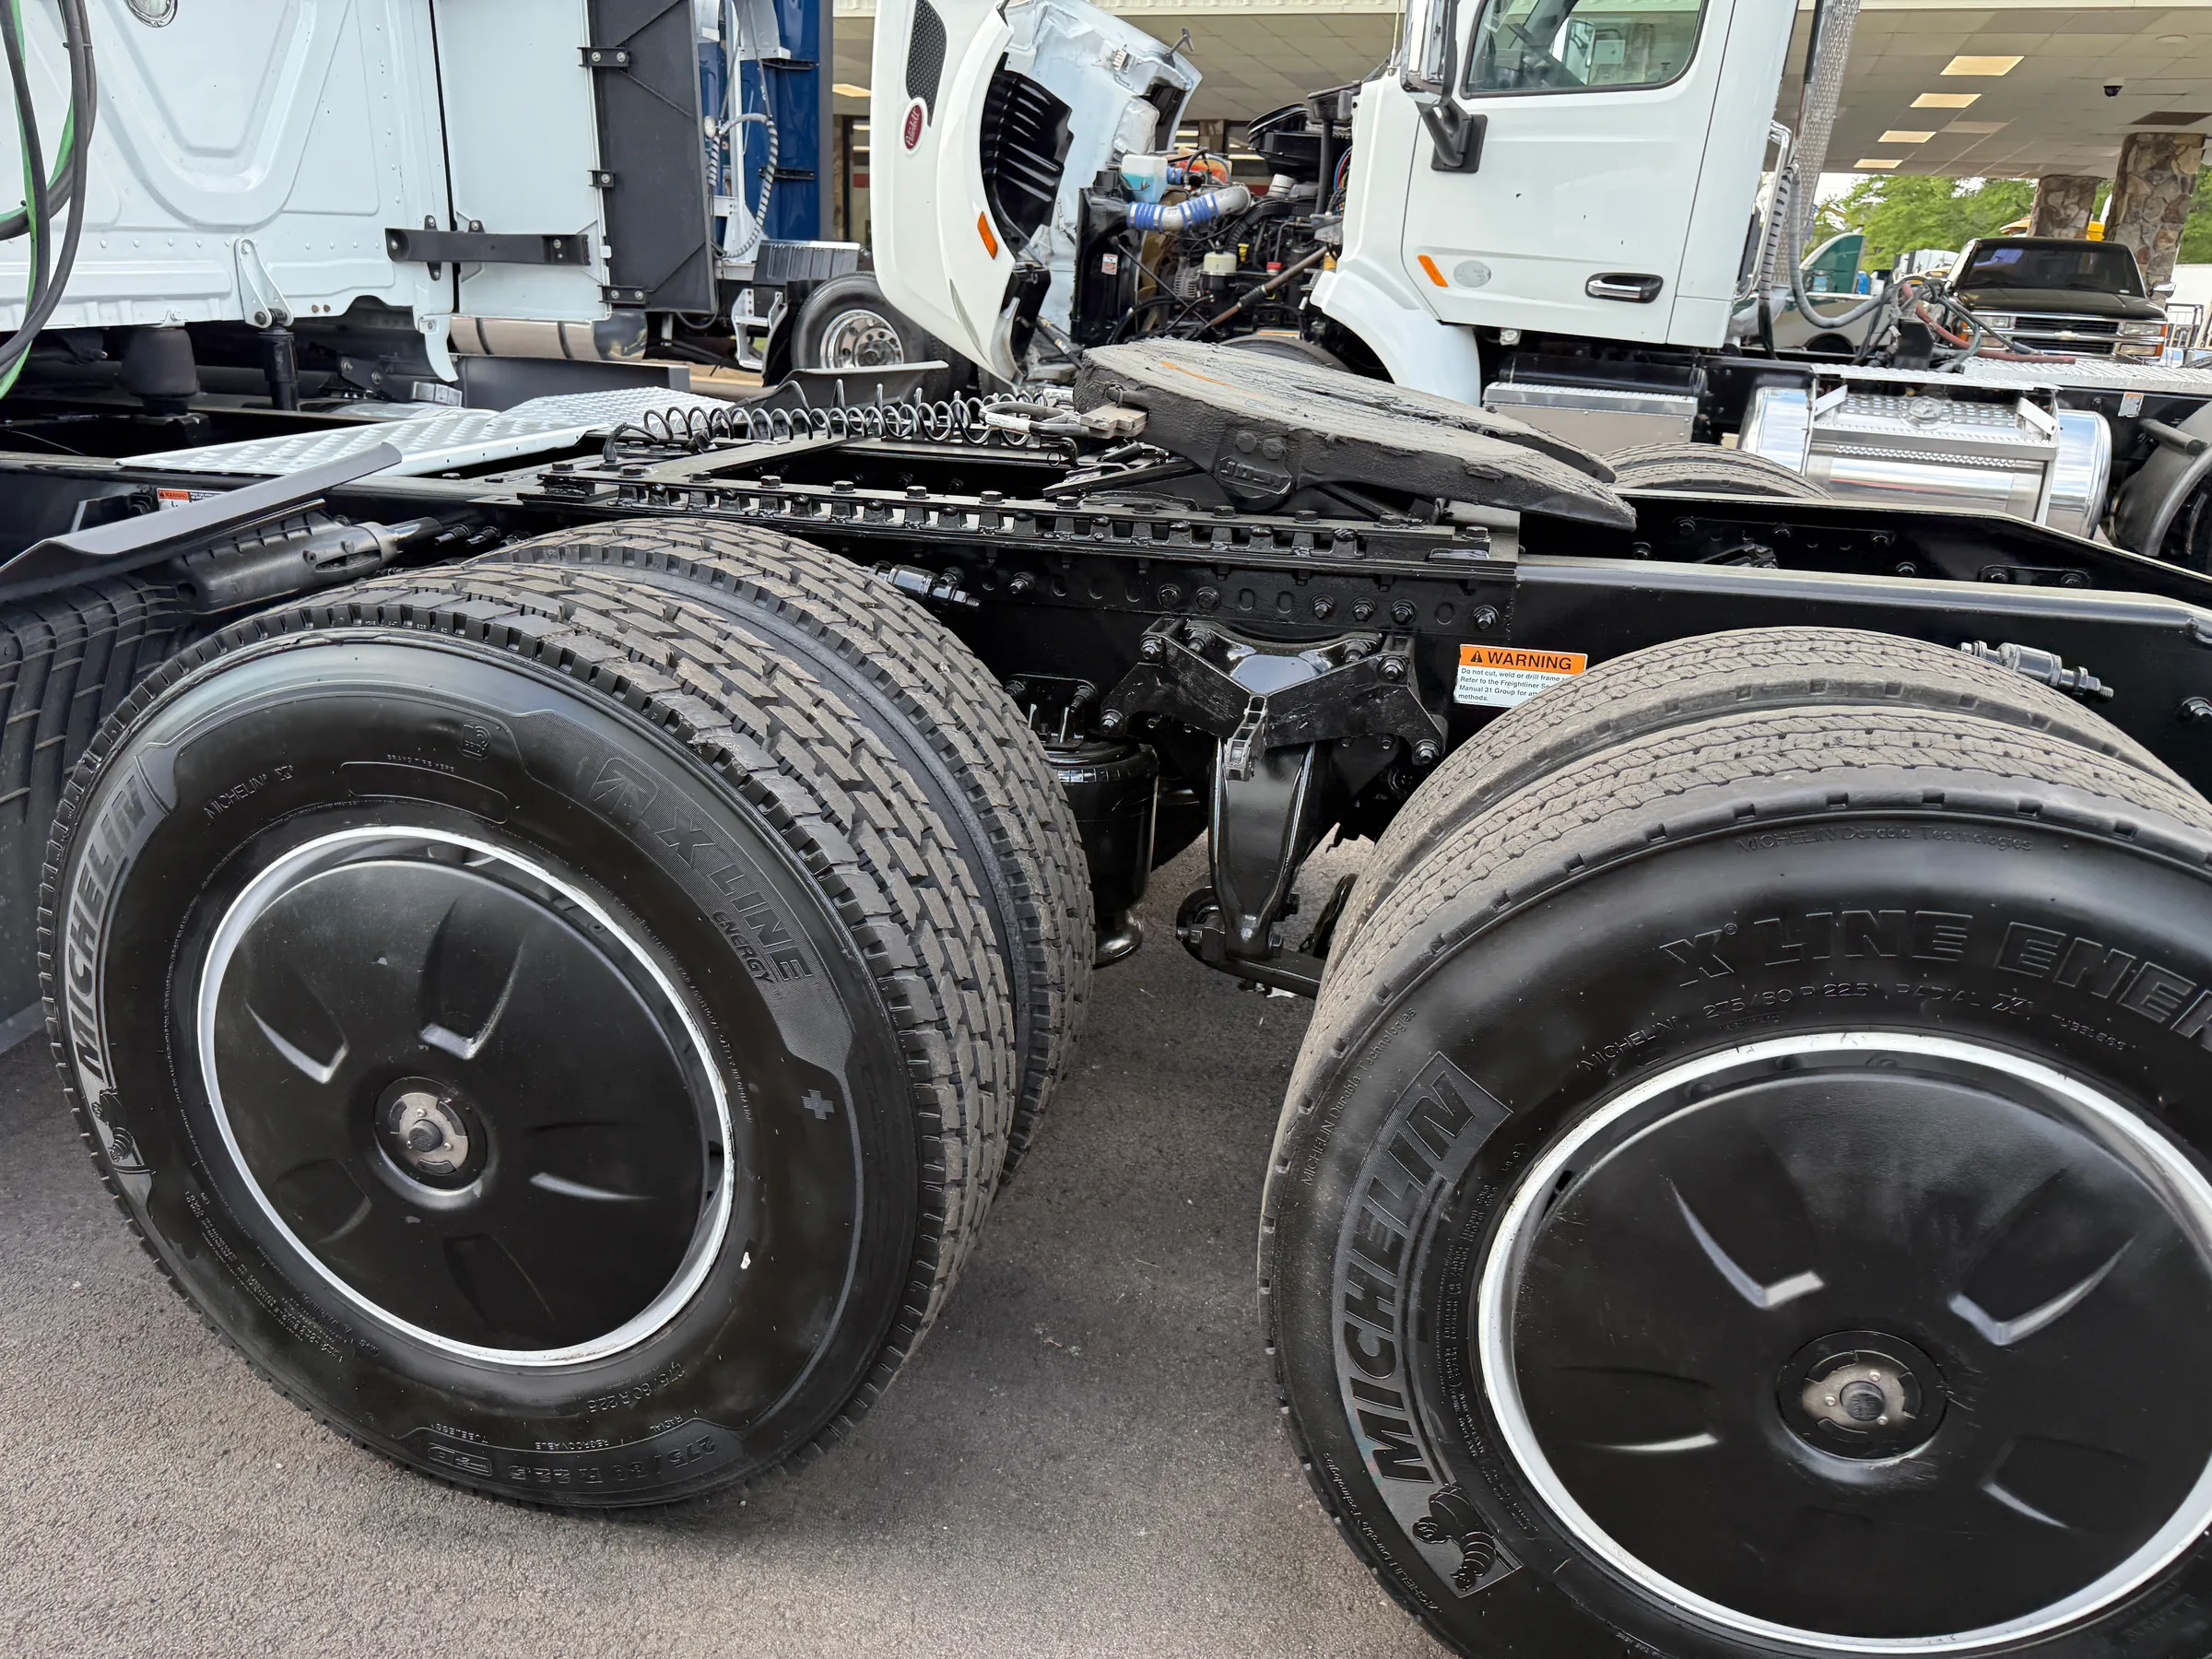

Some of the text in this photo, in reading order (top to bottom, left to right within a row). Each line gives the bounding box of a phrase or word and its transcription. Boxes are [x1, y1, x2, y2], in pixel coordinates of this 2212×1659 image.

[1488, 651, 1571, 670] WARNING
[1500, 680, 1538, 688] Freightliner
[204, 774, 265, 819] MICHELIN
[1920, 826, 2033, 852] Technologies
[654, 809, 813, 981] X LINE
[66, 774, 147, 1082] MICHELIN
[712, 909, 774, 983] ENERGY
[1754, 910, 1972, 966] LINE
[1581, 1017, 1676, 1071] MICHELIN
[1824, 982, 1870, 998] 22.5
[1300, 1007, 1417, 1186] MICHELIN Durable Technologies
[1343, 1070, 1475, 1484] MICHELIN
[535, 1439, 609, 1451] REGROOVABLE
[649, 1414, 683, 1432] RADIAL
